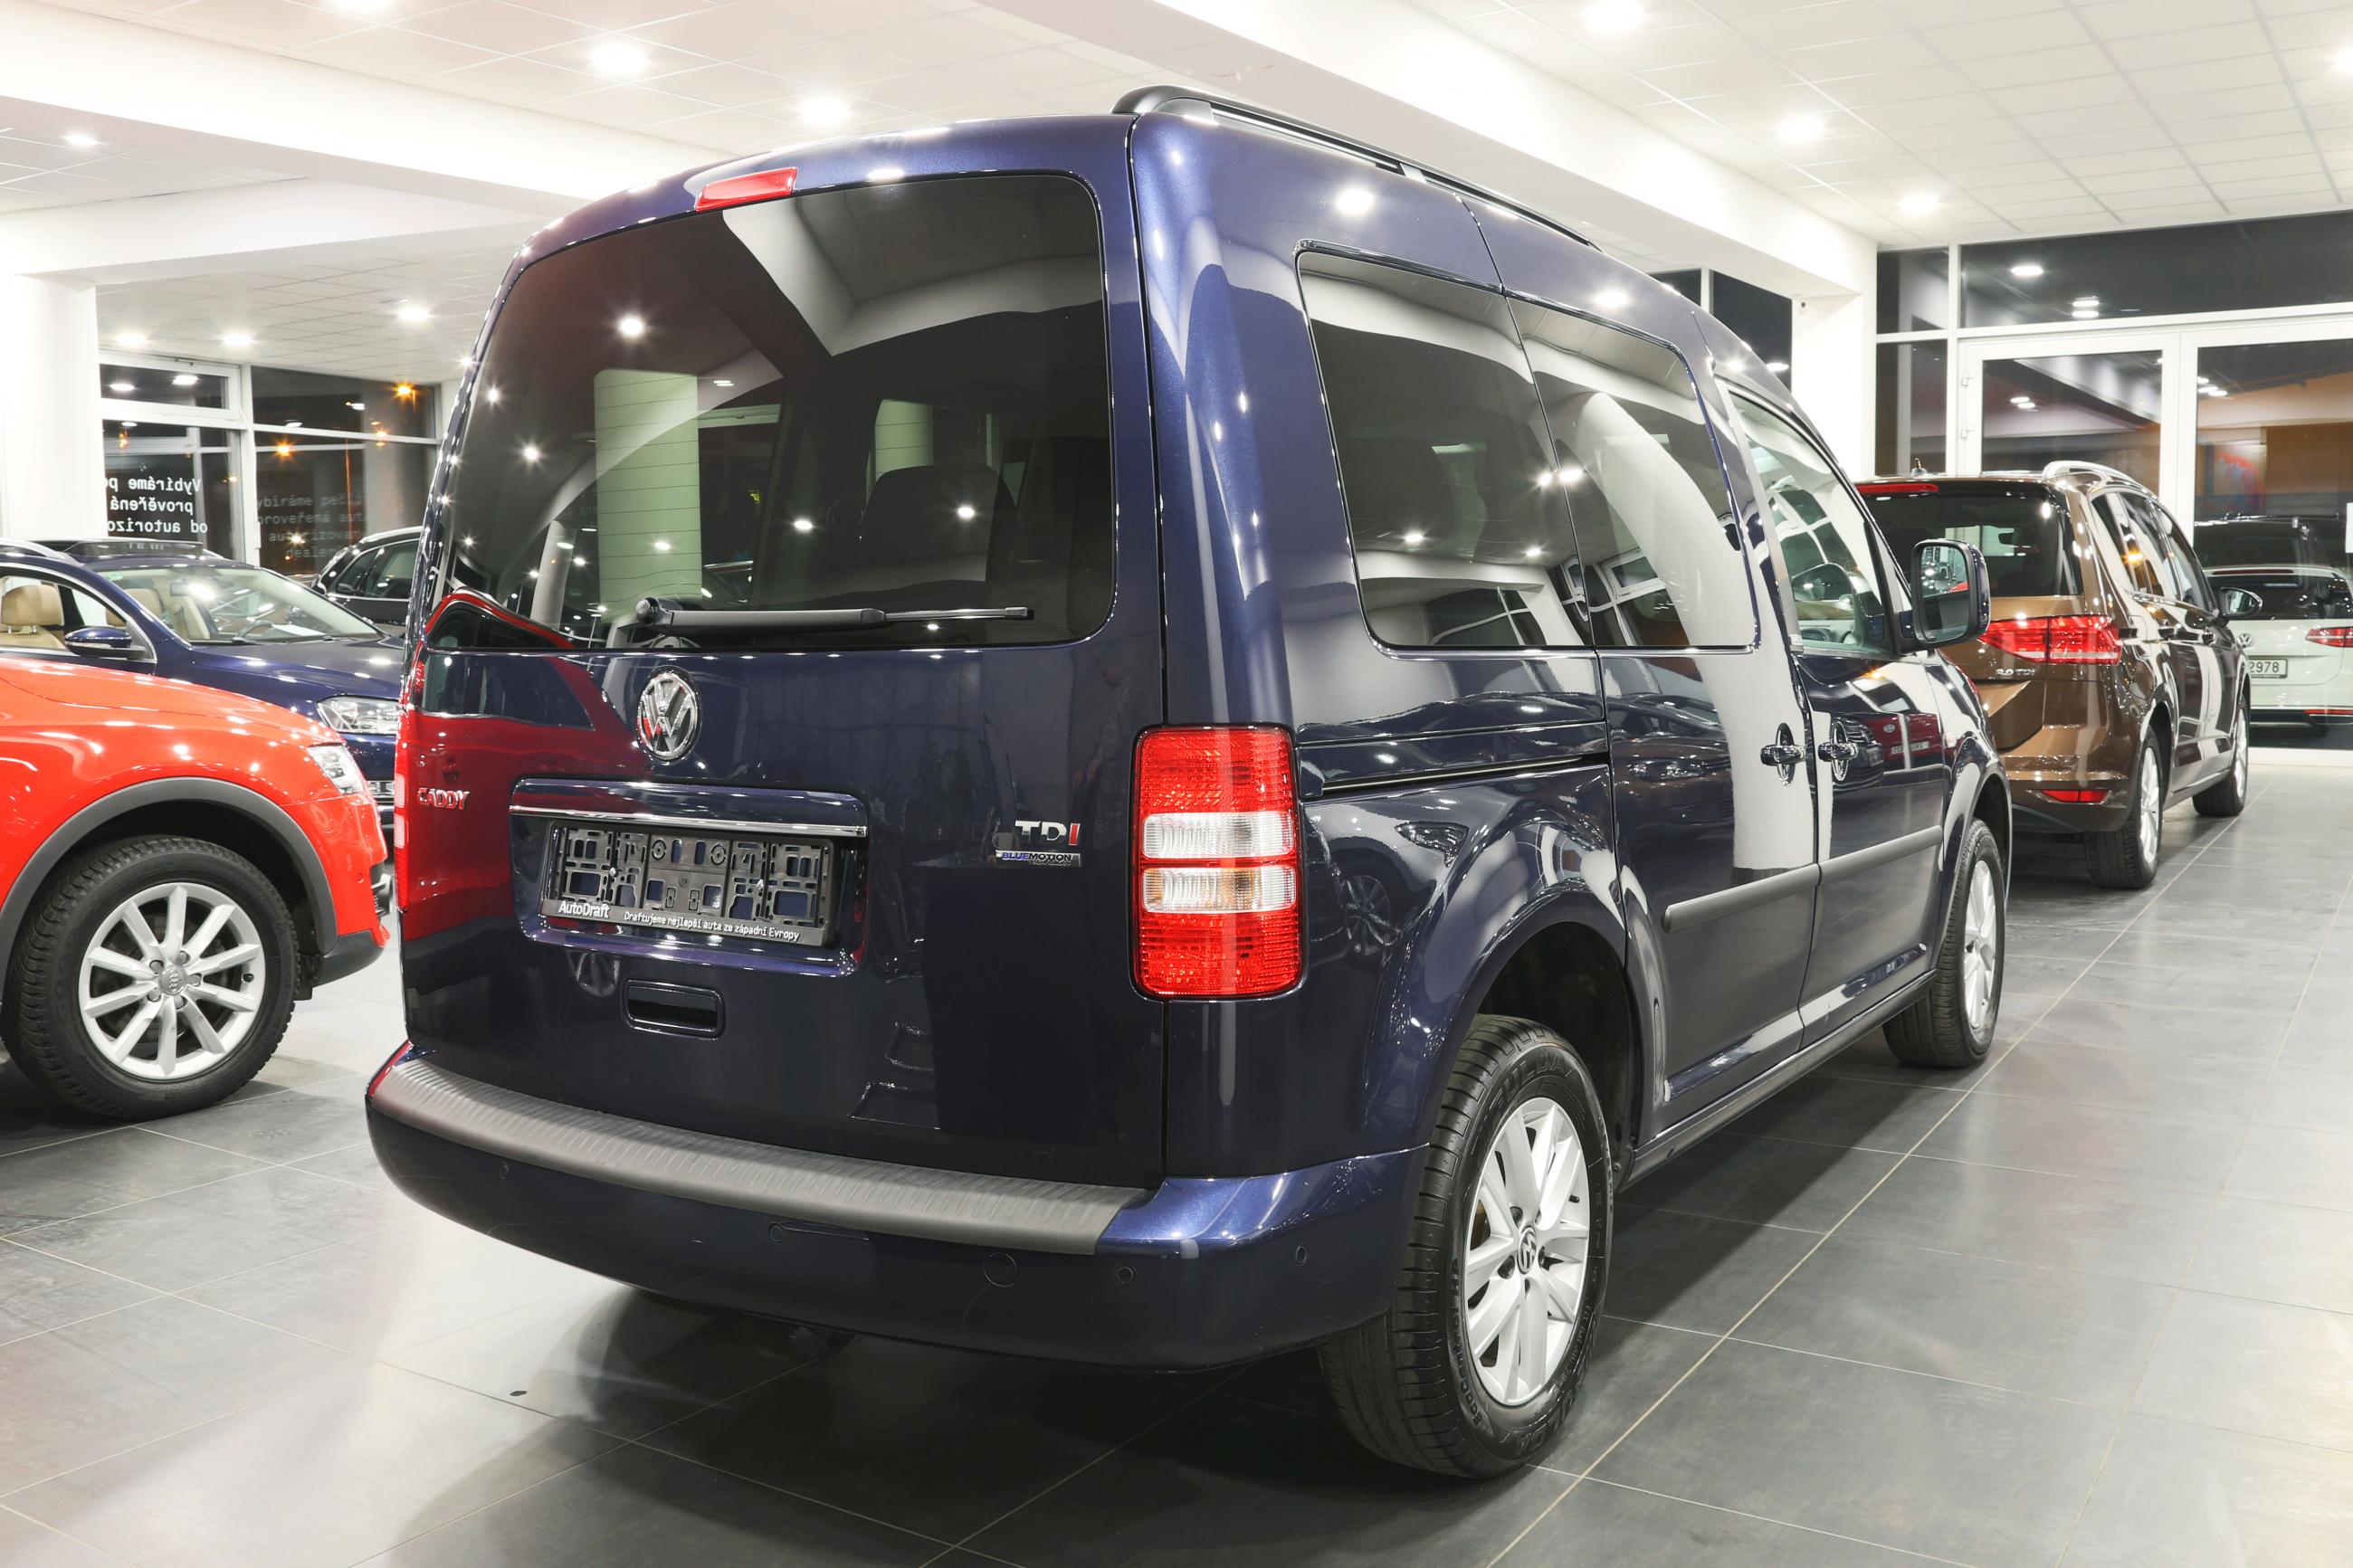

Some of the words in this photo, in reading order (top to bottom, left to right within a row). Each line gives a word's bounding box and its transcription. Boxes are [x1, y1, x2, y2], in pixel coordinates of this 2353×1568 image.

[417, 787, 471, 811] CADDY
[1015, 820, 1081, 846] TDI
[1002, 851, 1072, 862] BLUEMOTION
[558, 899, 610, 919] AutoDraft
[624, 911, 667, 926] Draftujeme
[667, 916, 701, 929] nejlepší
[703, 921, 722, 931] auta
[734, 924, 767, 936] západní
[768, 927, 800, 941] Evropy
